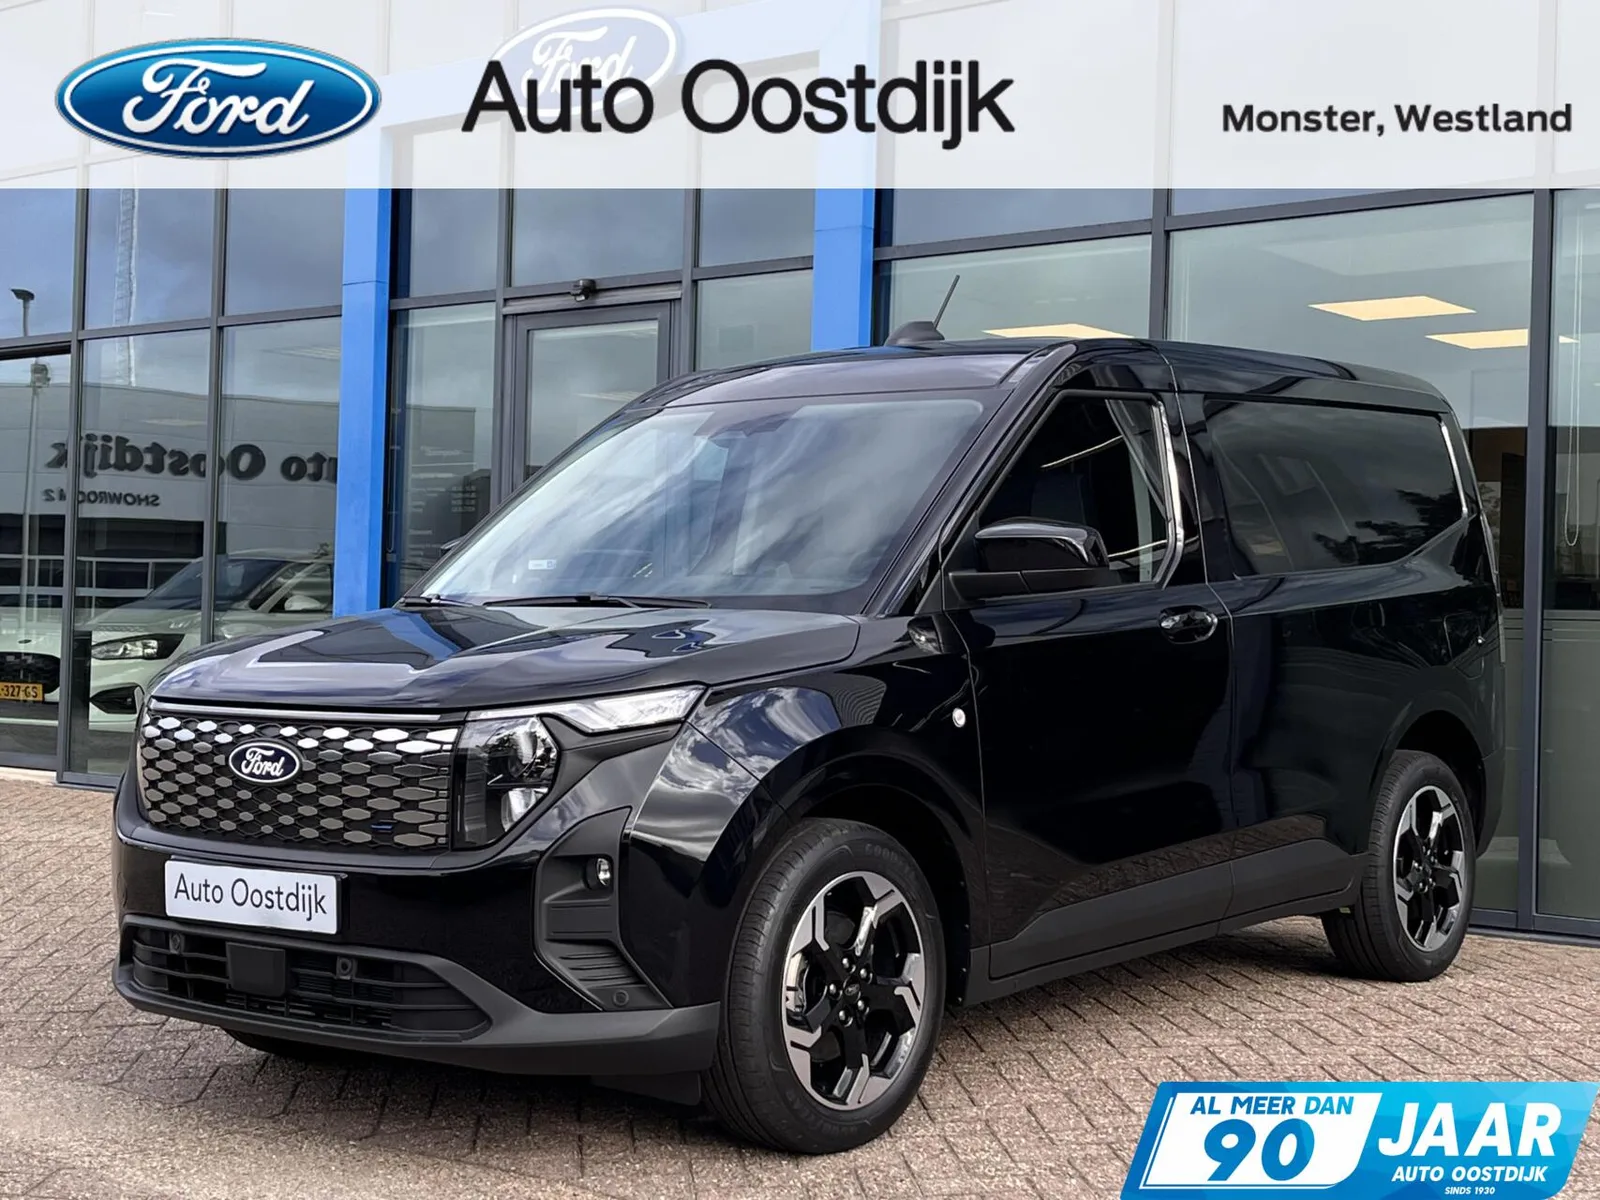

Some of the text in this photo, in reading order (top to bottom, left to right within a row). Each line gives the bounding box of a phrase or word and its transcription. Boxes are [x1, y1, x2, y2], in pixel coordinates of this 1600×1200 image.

[0, 684, 38, 698] -327-GS
[241, 747, 285, 777] Ford
[174, 872, 327, 921] Auto Oostdijk
